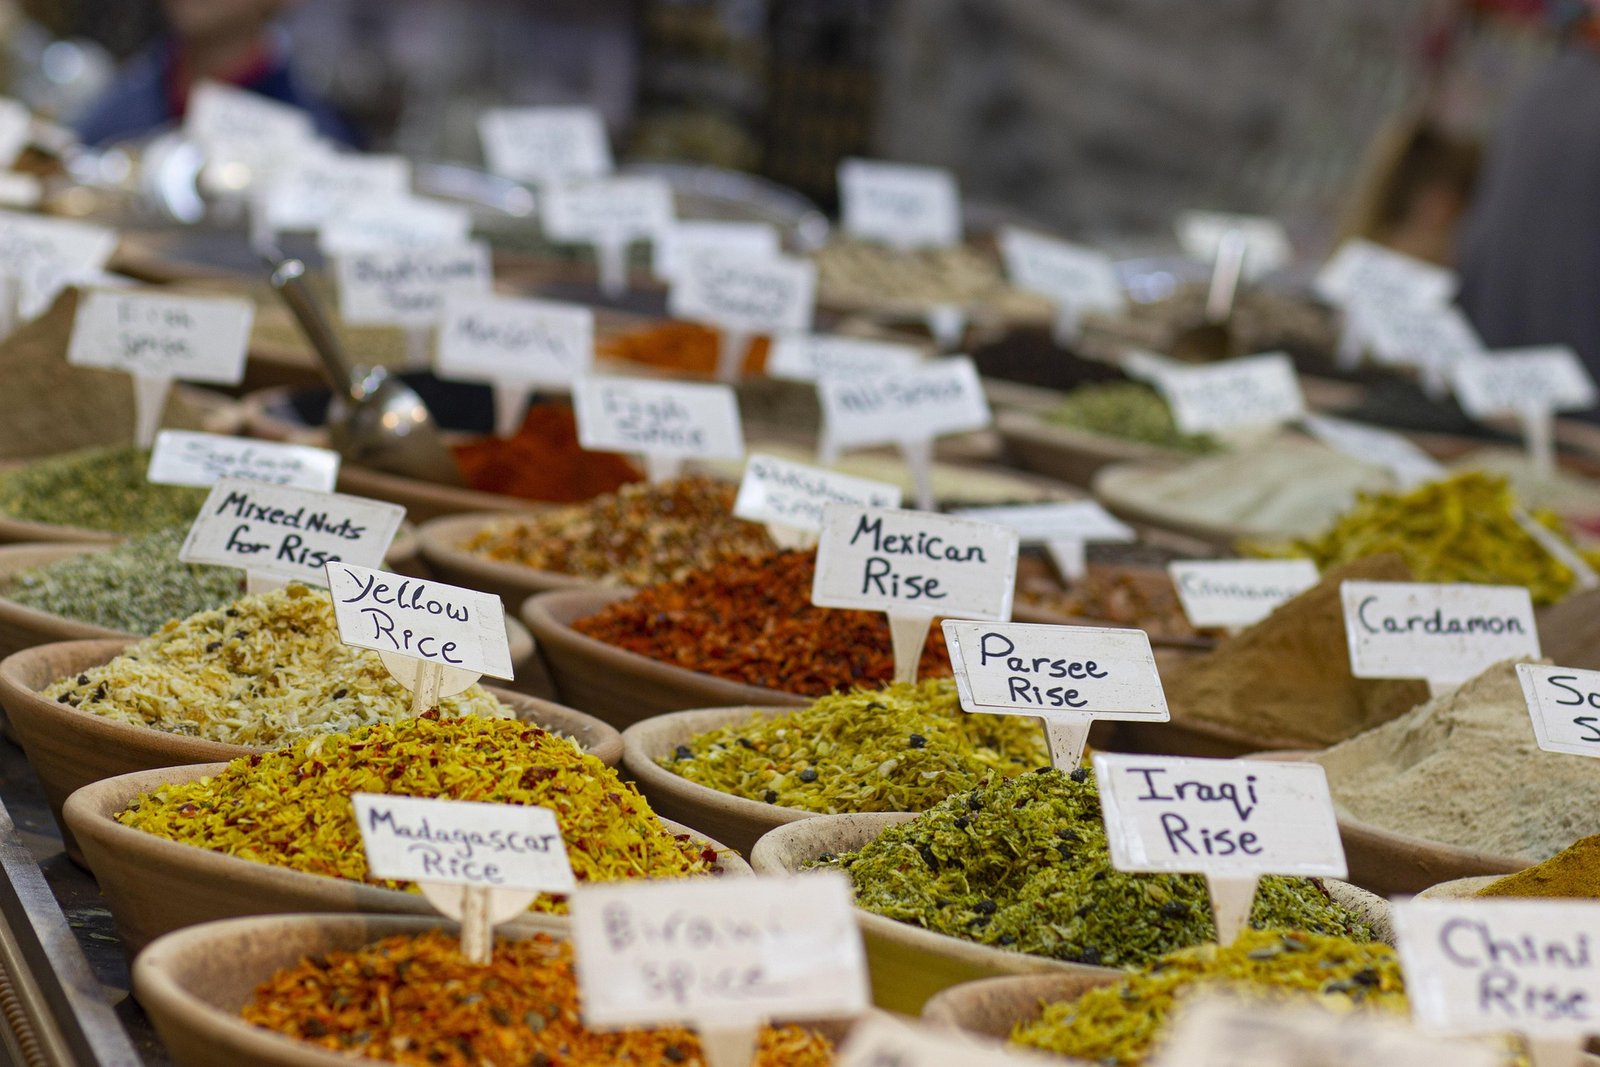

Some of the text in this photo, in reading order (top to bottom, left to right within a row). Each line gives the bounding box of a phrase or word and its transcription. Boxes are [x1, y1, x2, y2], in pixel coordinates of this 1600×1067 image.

[217, 492, 367, 541] Mixed Nuts
[226, 525, 270, 553] for
[851, 514, 988, 564] Mexican
[342, 568, 470, 624] Yellow
[862, 558, 948, 599] Rise
[360, 609, 464, 664] Rice
[1358, 595, 1528, 636] Cardamon
[980, 632, 1108, 680] Parsee
[1007, 677, 1088, 708] Rise
[1126, 767, 1259, 822] Iraqi
[368, 806, 556, 858] Madagascar
[1161, 812, 1264, 856] Rise
[407, 843, 505, 884] Rice
[1478, 969, 1592, 1022] Rise
